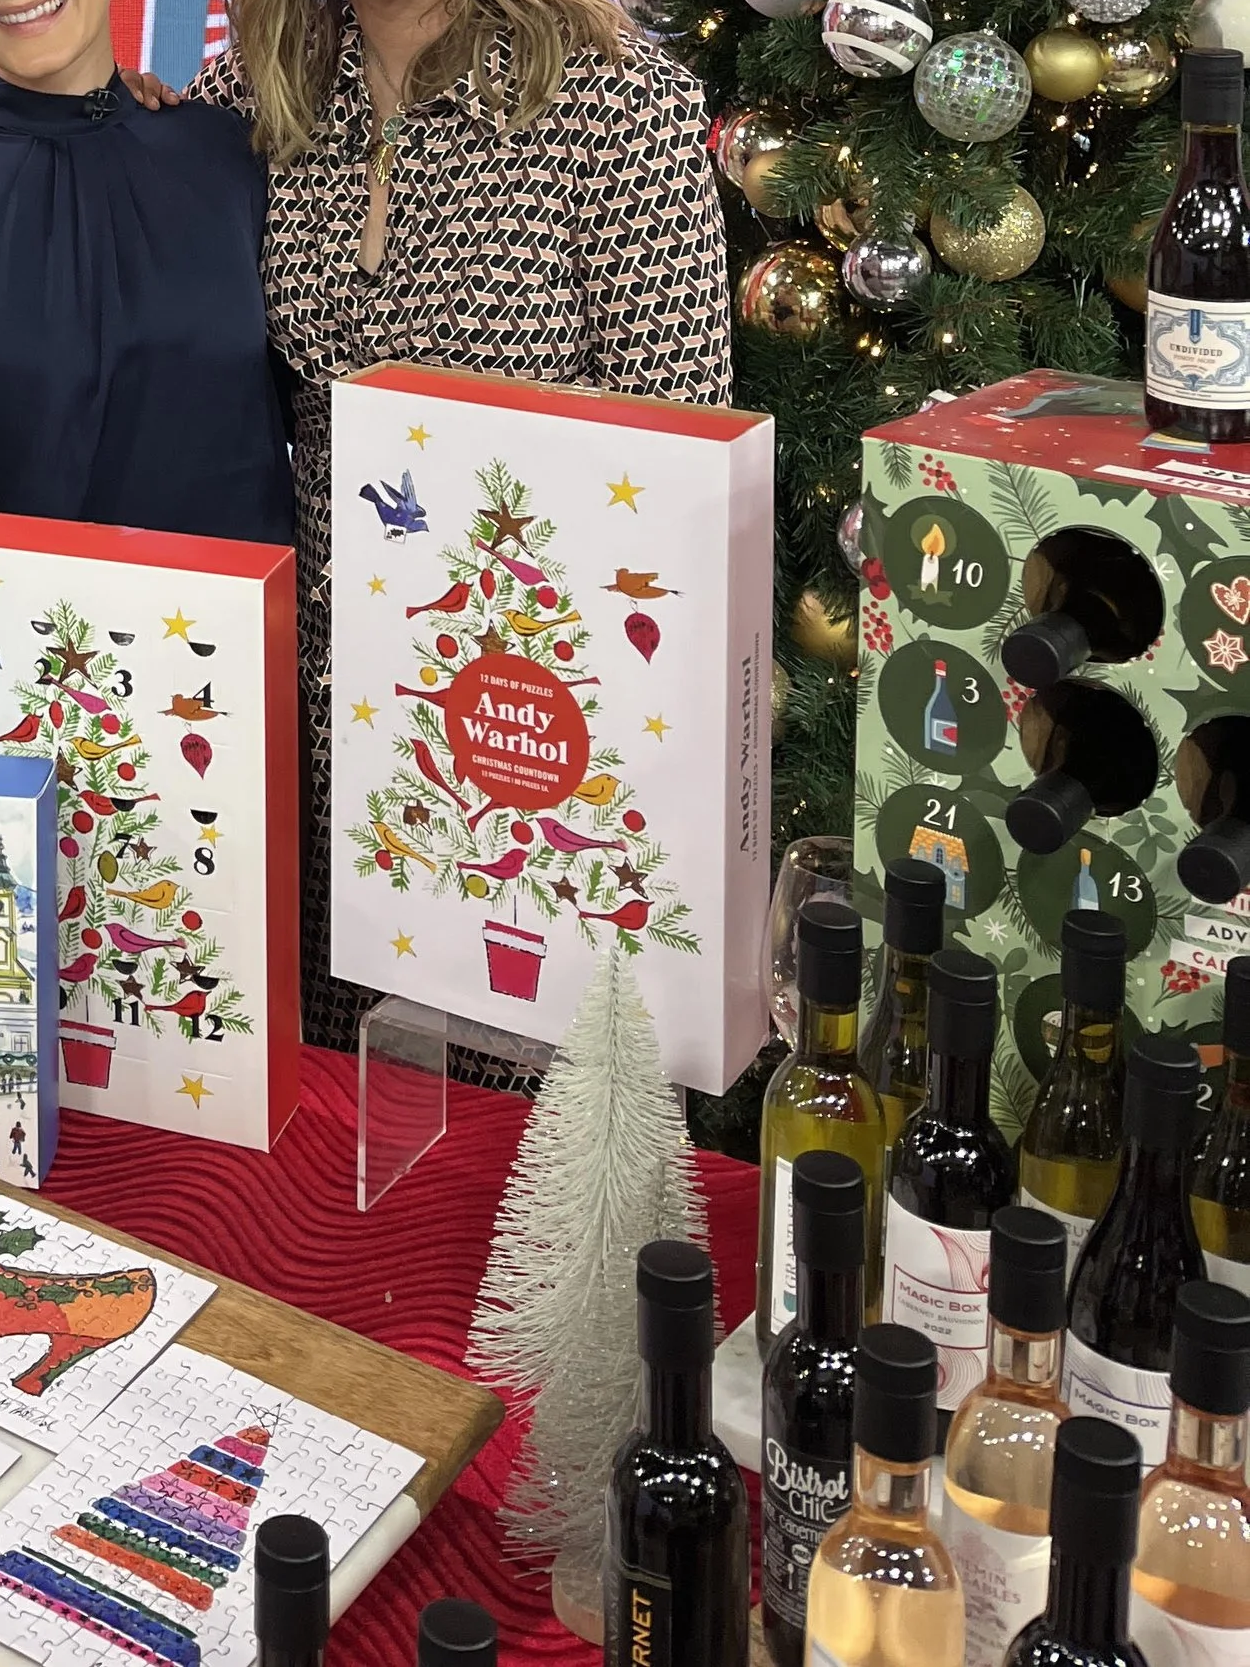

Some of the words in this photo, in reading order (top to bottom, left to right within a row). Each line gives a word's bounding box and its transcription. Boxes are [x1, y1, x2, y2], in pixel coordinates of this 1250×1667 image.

[1170, 343, 1223, 357] UNDIVIDED
[951, 559, 984, 588] 10
[35, 658, 53, 684] 2
[111, 669, 133, 697] 3
[480, 673, 489, 683] 12
[490, 676, 508, 688] DAYS
[510, 681, 520, 689] OF
[521, 683, 553, 698] PUZZLES
[193, 681, 215, 709] 4
[961, 678, 980, 704] 3
[474, 691, 555, 734] Andy
[740, 656, 751, 772] Warhol
[460, 716, 569, 765] Warhol
[472, 754, 512, 772] CHRISTMAS
[513, 764, 559, 783] COUNTDOWN
[740, 776, 751, 852] Andy
[923, 798, 957, 829] 21
[114, 834, 134, 859] 7
[194, 847, 215, 875] 8
[1109, 872, 1143, 902] 13
[111, 997, 141, 1027] 11
[189, 1013, 224, 1042] 12
[899, 1281, 945, 1309] MAGIC
[1074, 1388, 1120, 1420] MAGIC
[766, 1438, 849, 1500] Bistrot
